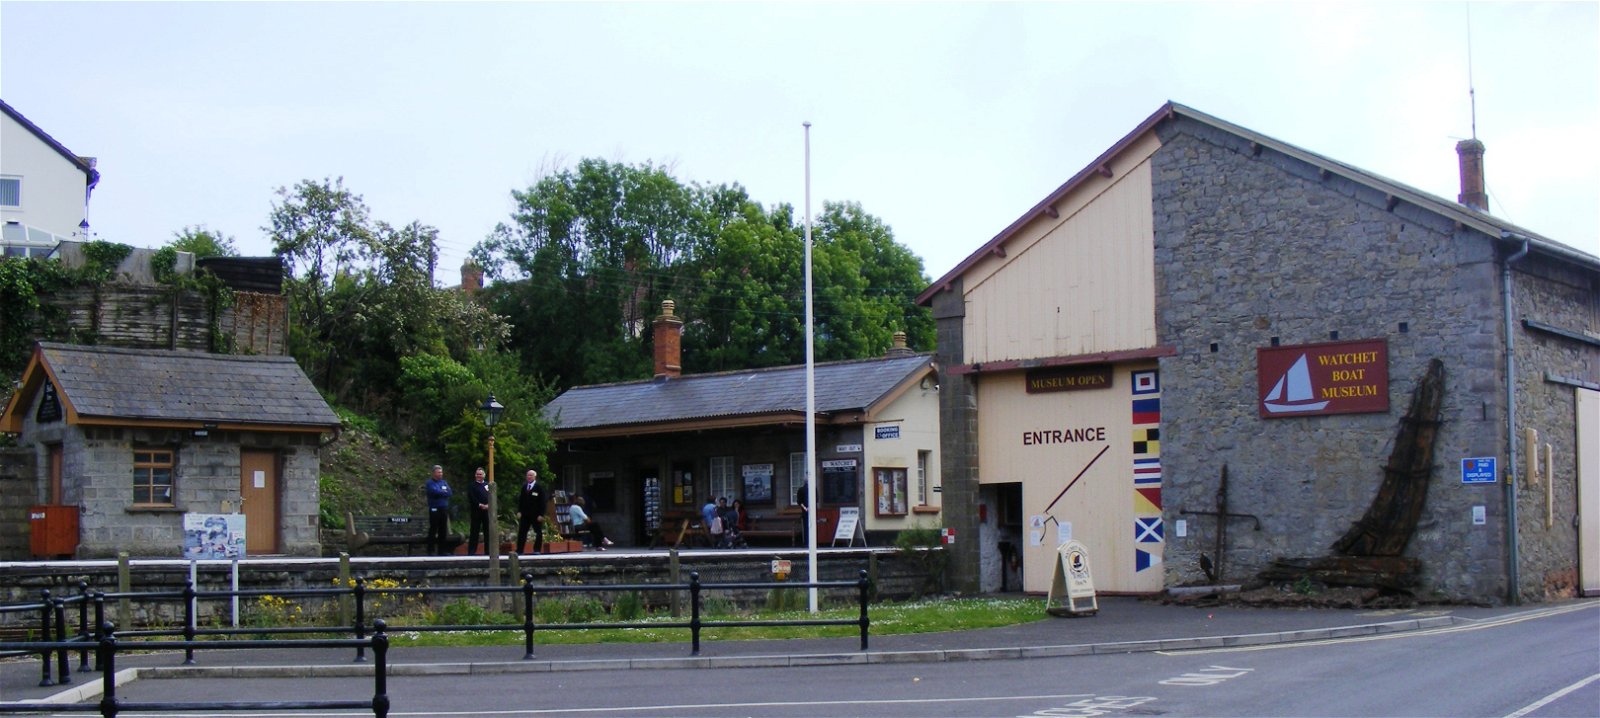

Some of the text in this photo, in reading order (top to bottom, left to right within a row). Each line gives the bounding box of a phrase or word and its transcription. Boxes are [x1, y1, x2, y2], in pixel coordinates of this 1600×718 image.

[1318, 351, 1378, 366] WATCHET
[1031, 374, 1105, 389] MUSEUM OPEN
[1332, 368, 1365, 382] BOAT
[1321, 384, 1377, 399] MUSEUM
[1023, 427, 1106, 446] ENTRANCE
[1158, 665, 1255, 686] ONLY
